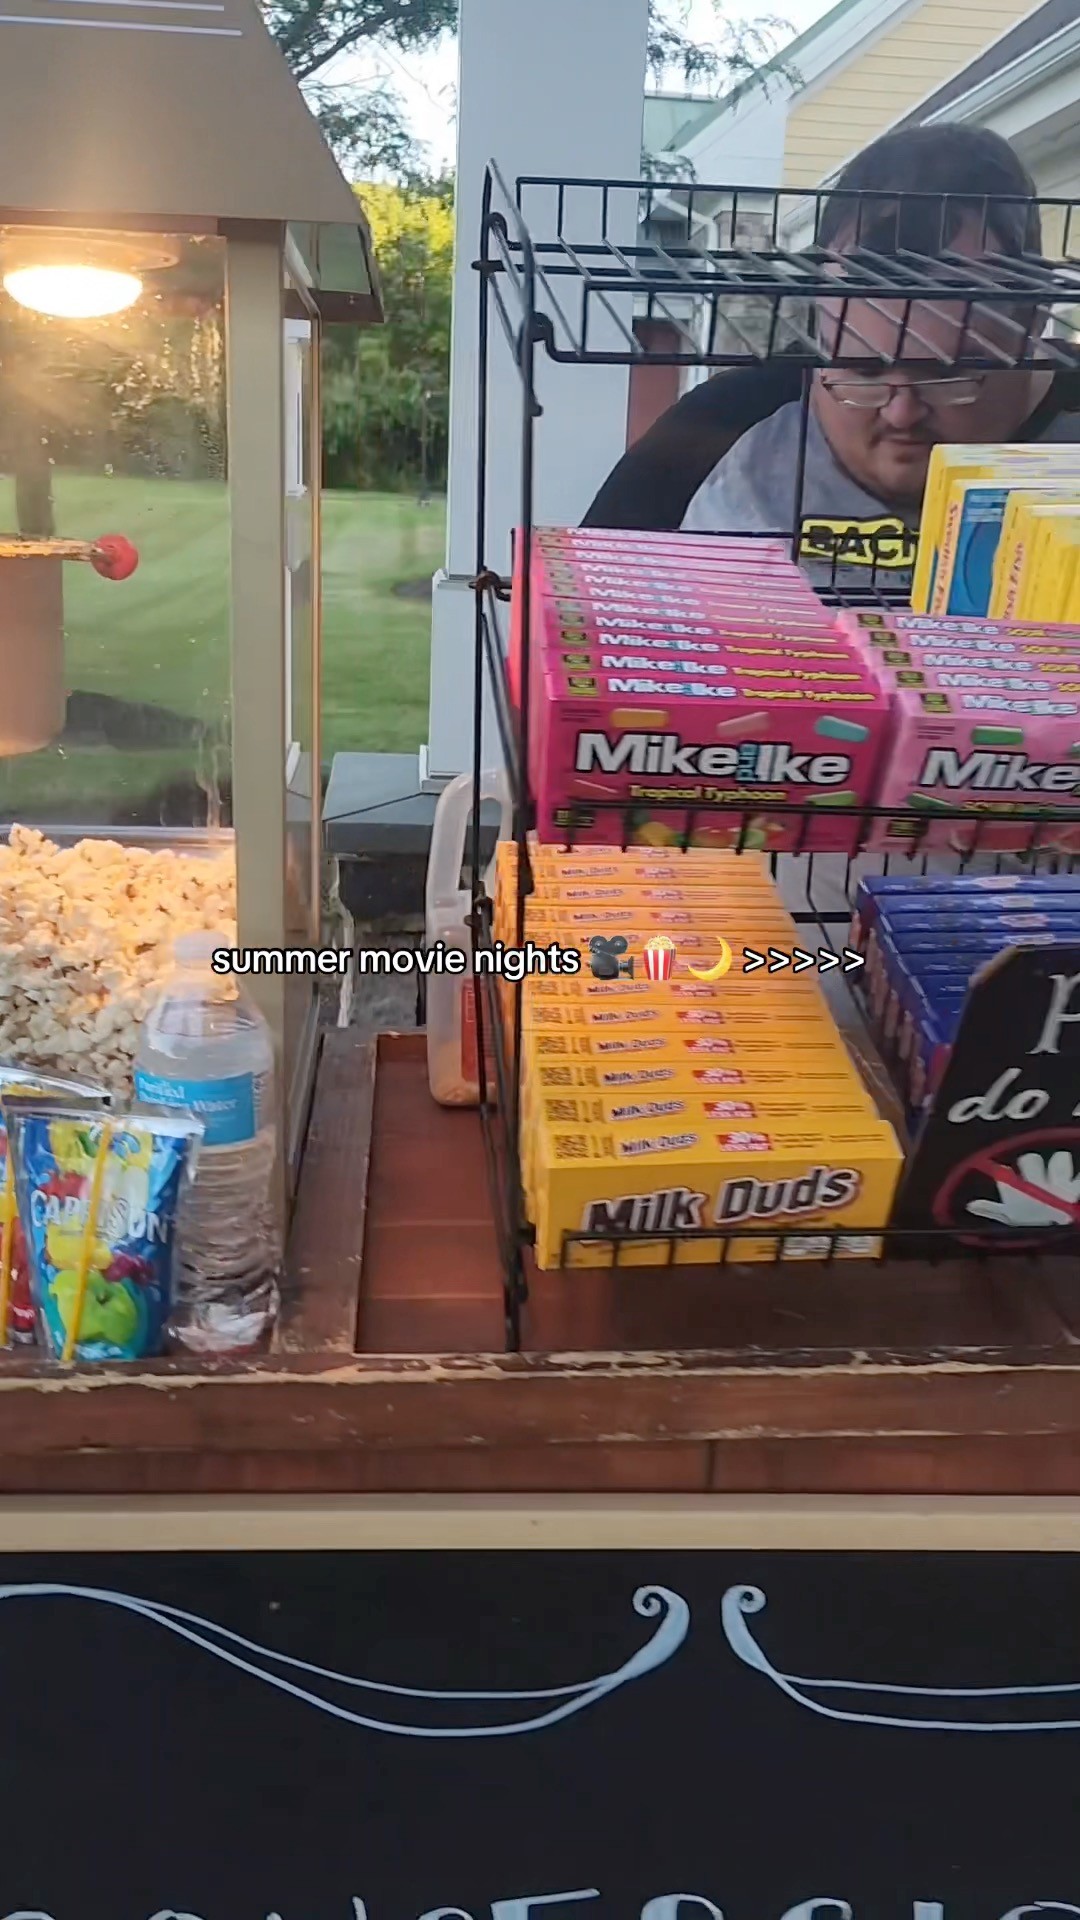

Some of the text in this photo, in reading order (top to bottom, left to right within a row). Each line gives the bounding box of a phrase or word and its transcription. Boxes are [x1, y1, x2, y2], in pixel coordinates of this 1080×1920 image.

[601, 655, 676, 671] Mike
[607, 678, 682, 694] Mike
[575, 732, 739, 777] Mike
[756, 742, 851, 784] Ike
[919, 748, 1080, 791] Mike
[948, 1067, 1049, 1124] do
[583, 1165, 861, 1235] Milk Duds
